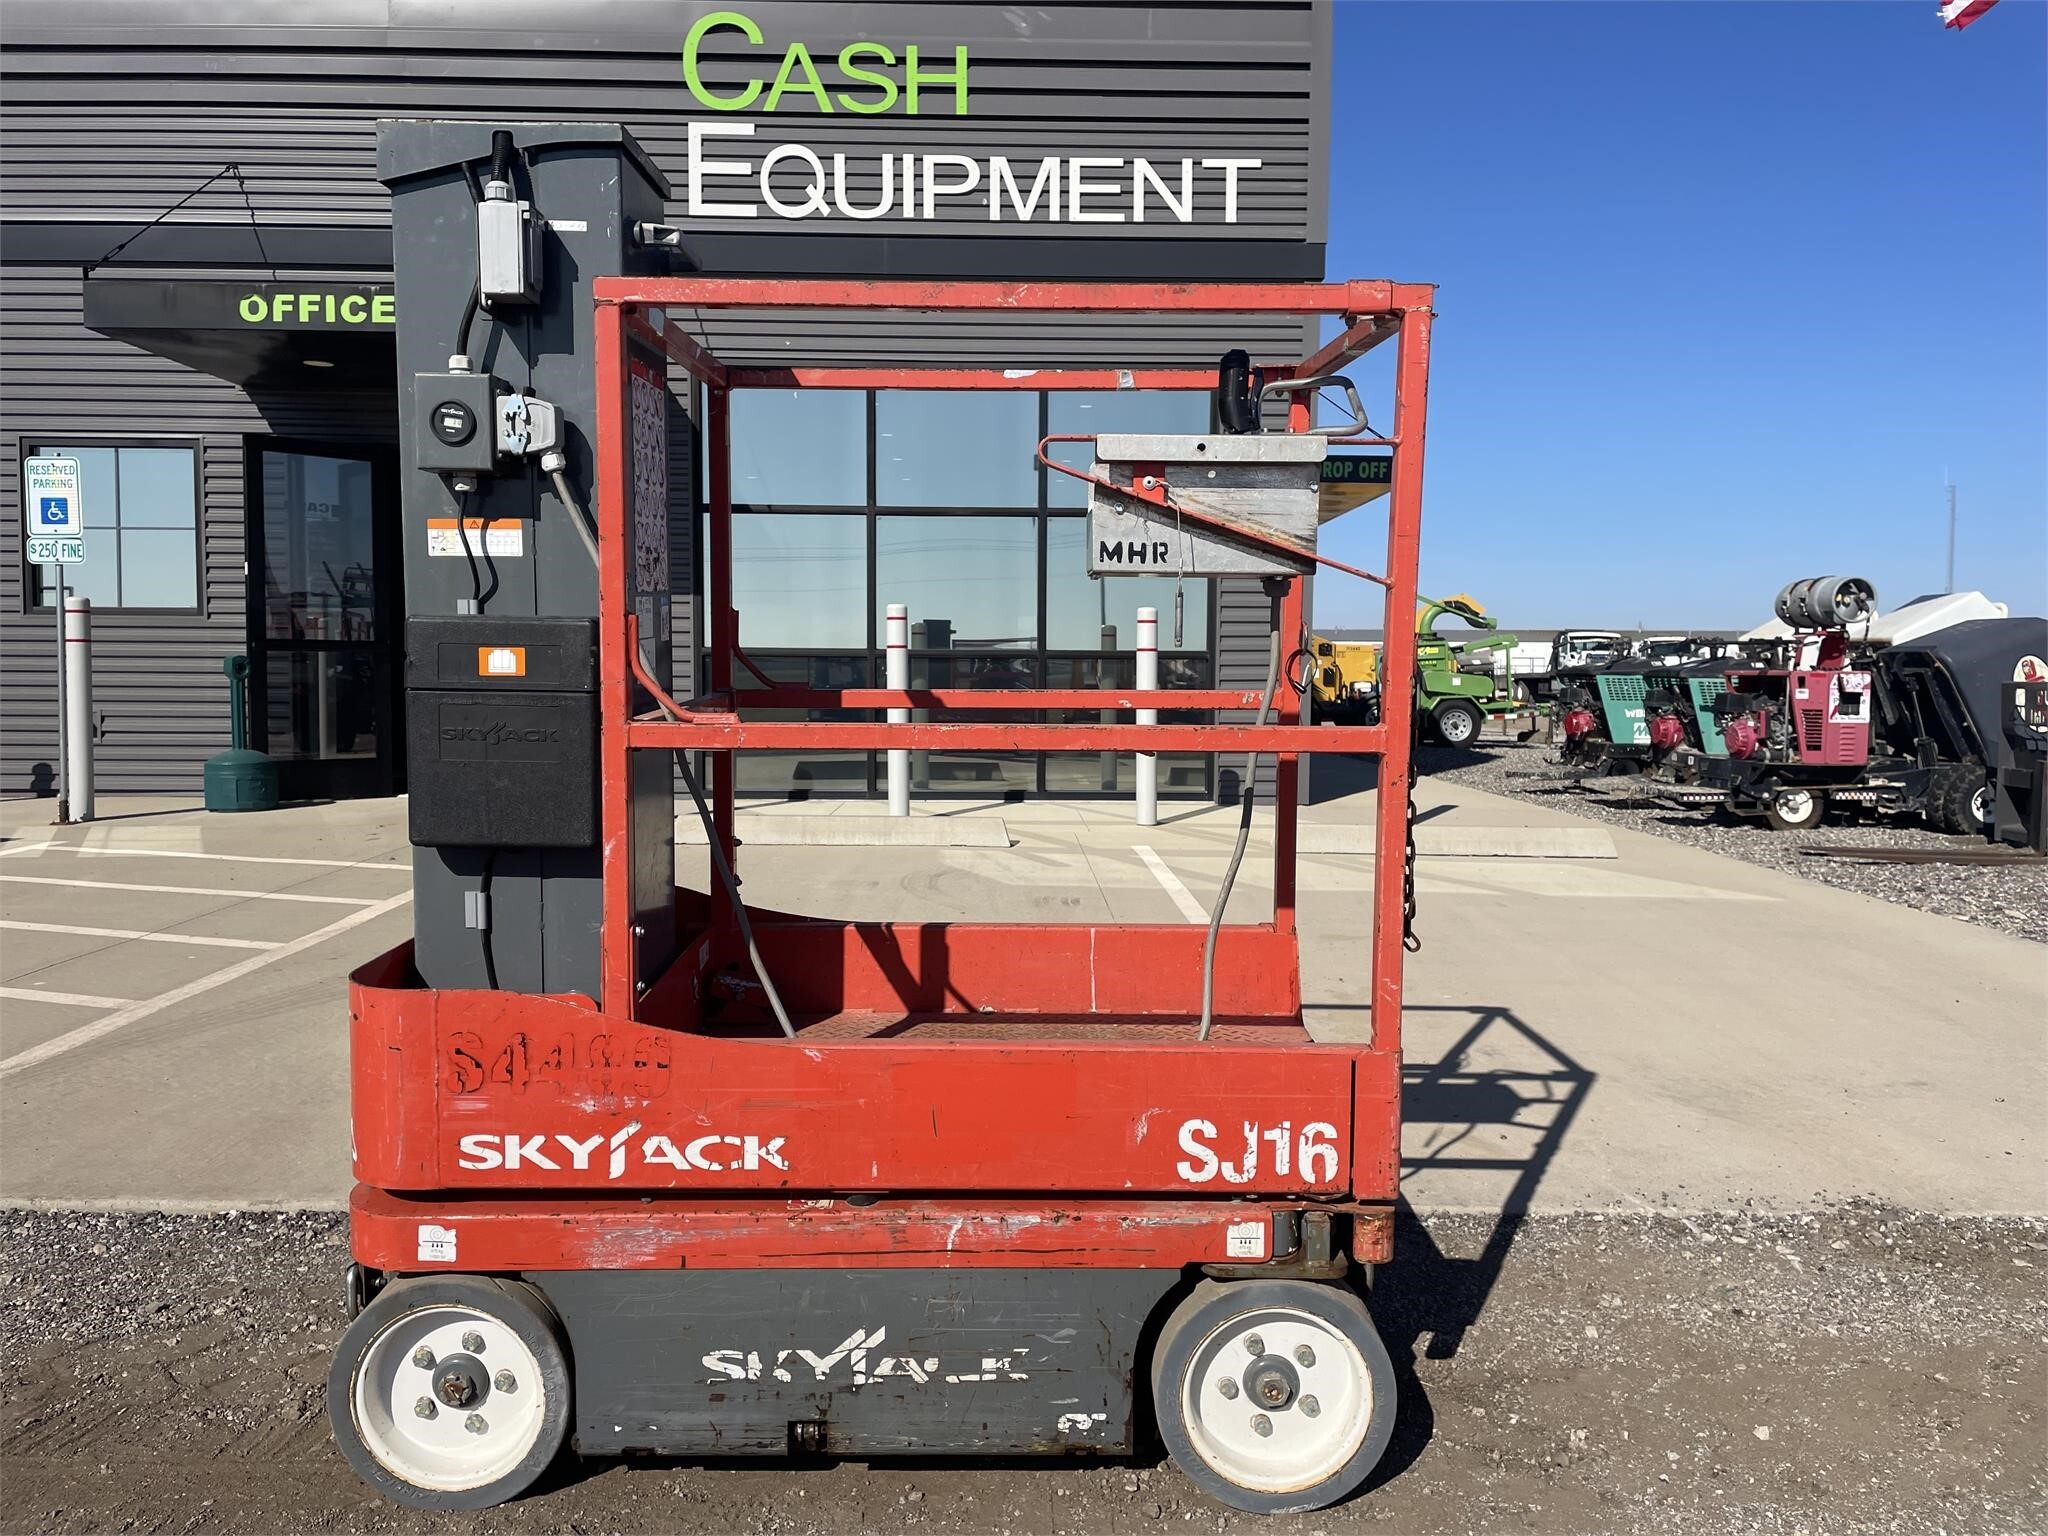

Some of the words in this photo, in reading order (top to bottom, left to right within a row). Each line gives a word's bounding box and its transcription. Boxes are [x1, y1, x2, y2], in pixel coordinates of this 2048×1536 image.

[683, 12, 968, 115] CASH
[687, 122, 1262, 223] EQUIPMENT
[239, 294, 396, 323] OFFICE
[29, 465, 75, 475] RESERVED
[1321, 460, 1353, 479] ROP
[1358, 460, 1388, 479] OFF
[33, 479, 72, 488] PARKING
[61, 543, 83, 558] FINE
[1100, 540, 1168, 565] MHR
[441, 720, 561, 746] SKYJACK
[458, 1120, 790, 1180] SKYJACK
[1176, 1118, 1339, 1185] SJ16
